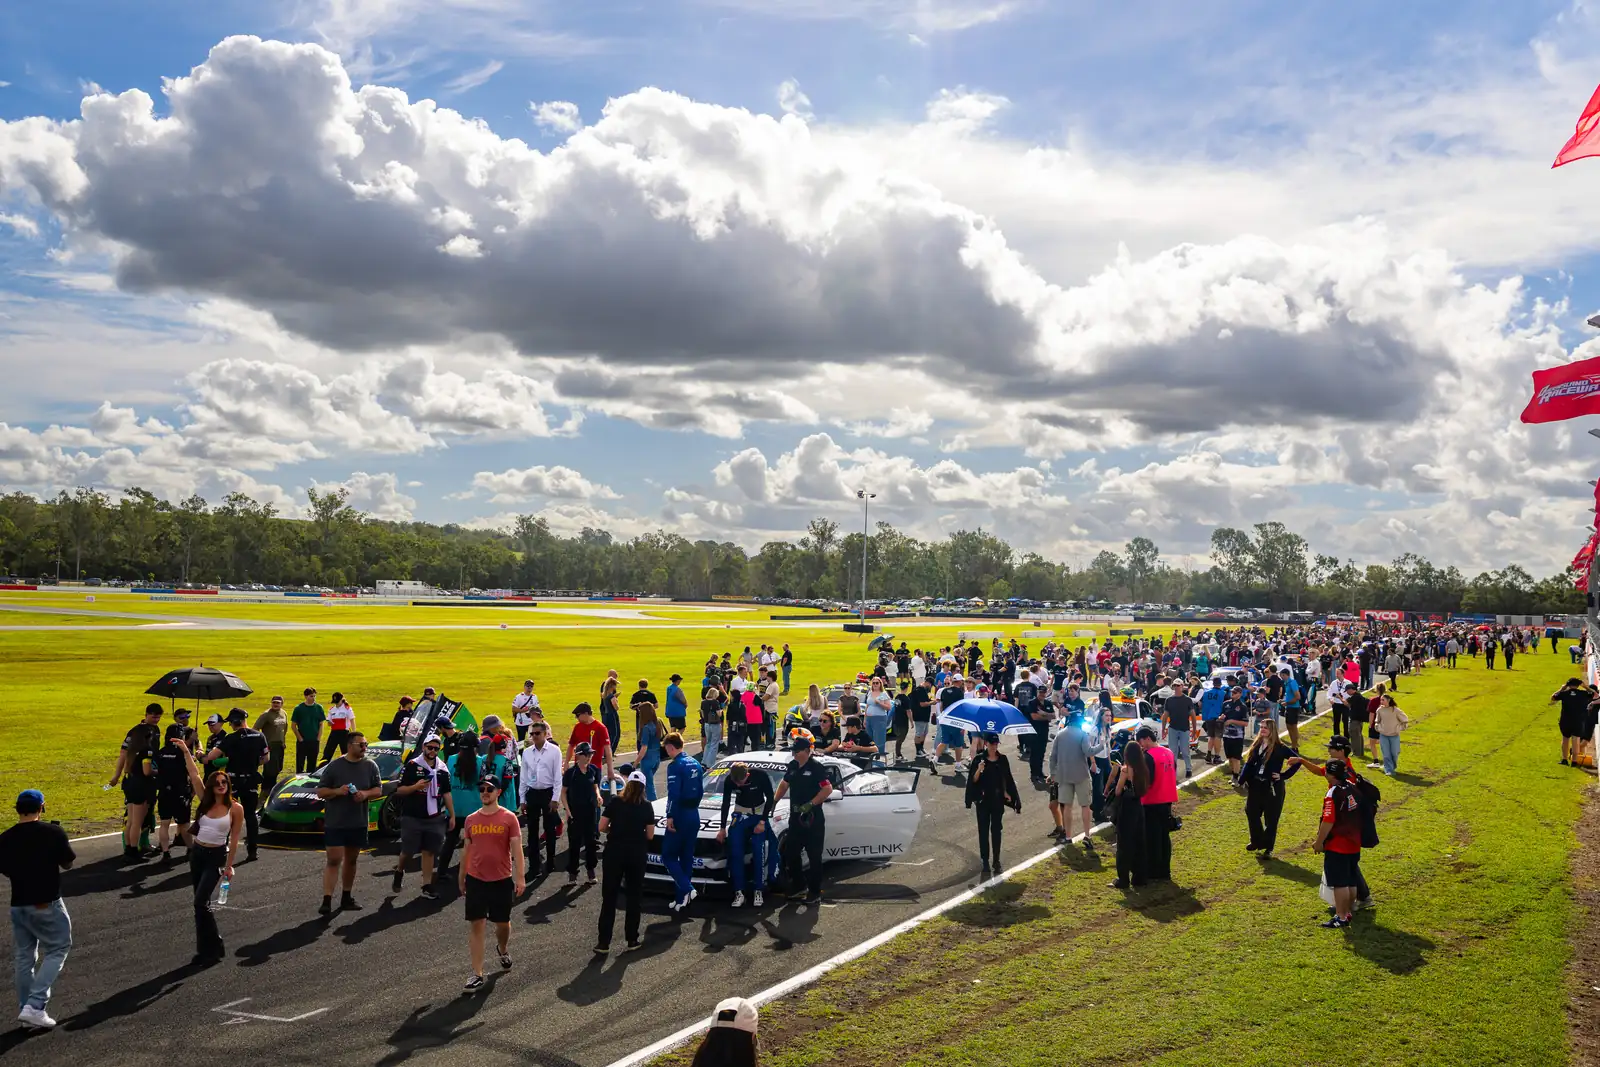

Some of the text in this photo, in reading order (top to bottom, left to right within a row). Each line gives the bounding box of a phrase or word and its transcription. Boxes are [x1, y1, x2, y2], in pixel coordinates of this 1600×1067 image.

[1539, 384, 1600, 405] RACEWA
[427, 700, 452, 736] QURTZ
[471, 823, 505, 835] Bloke
[826, 843, 904, 857] WESTLINK
